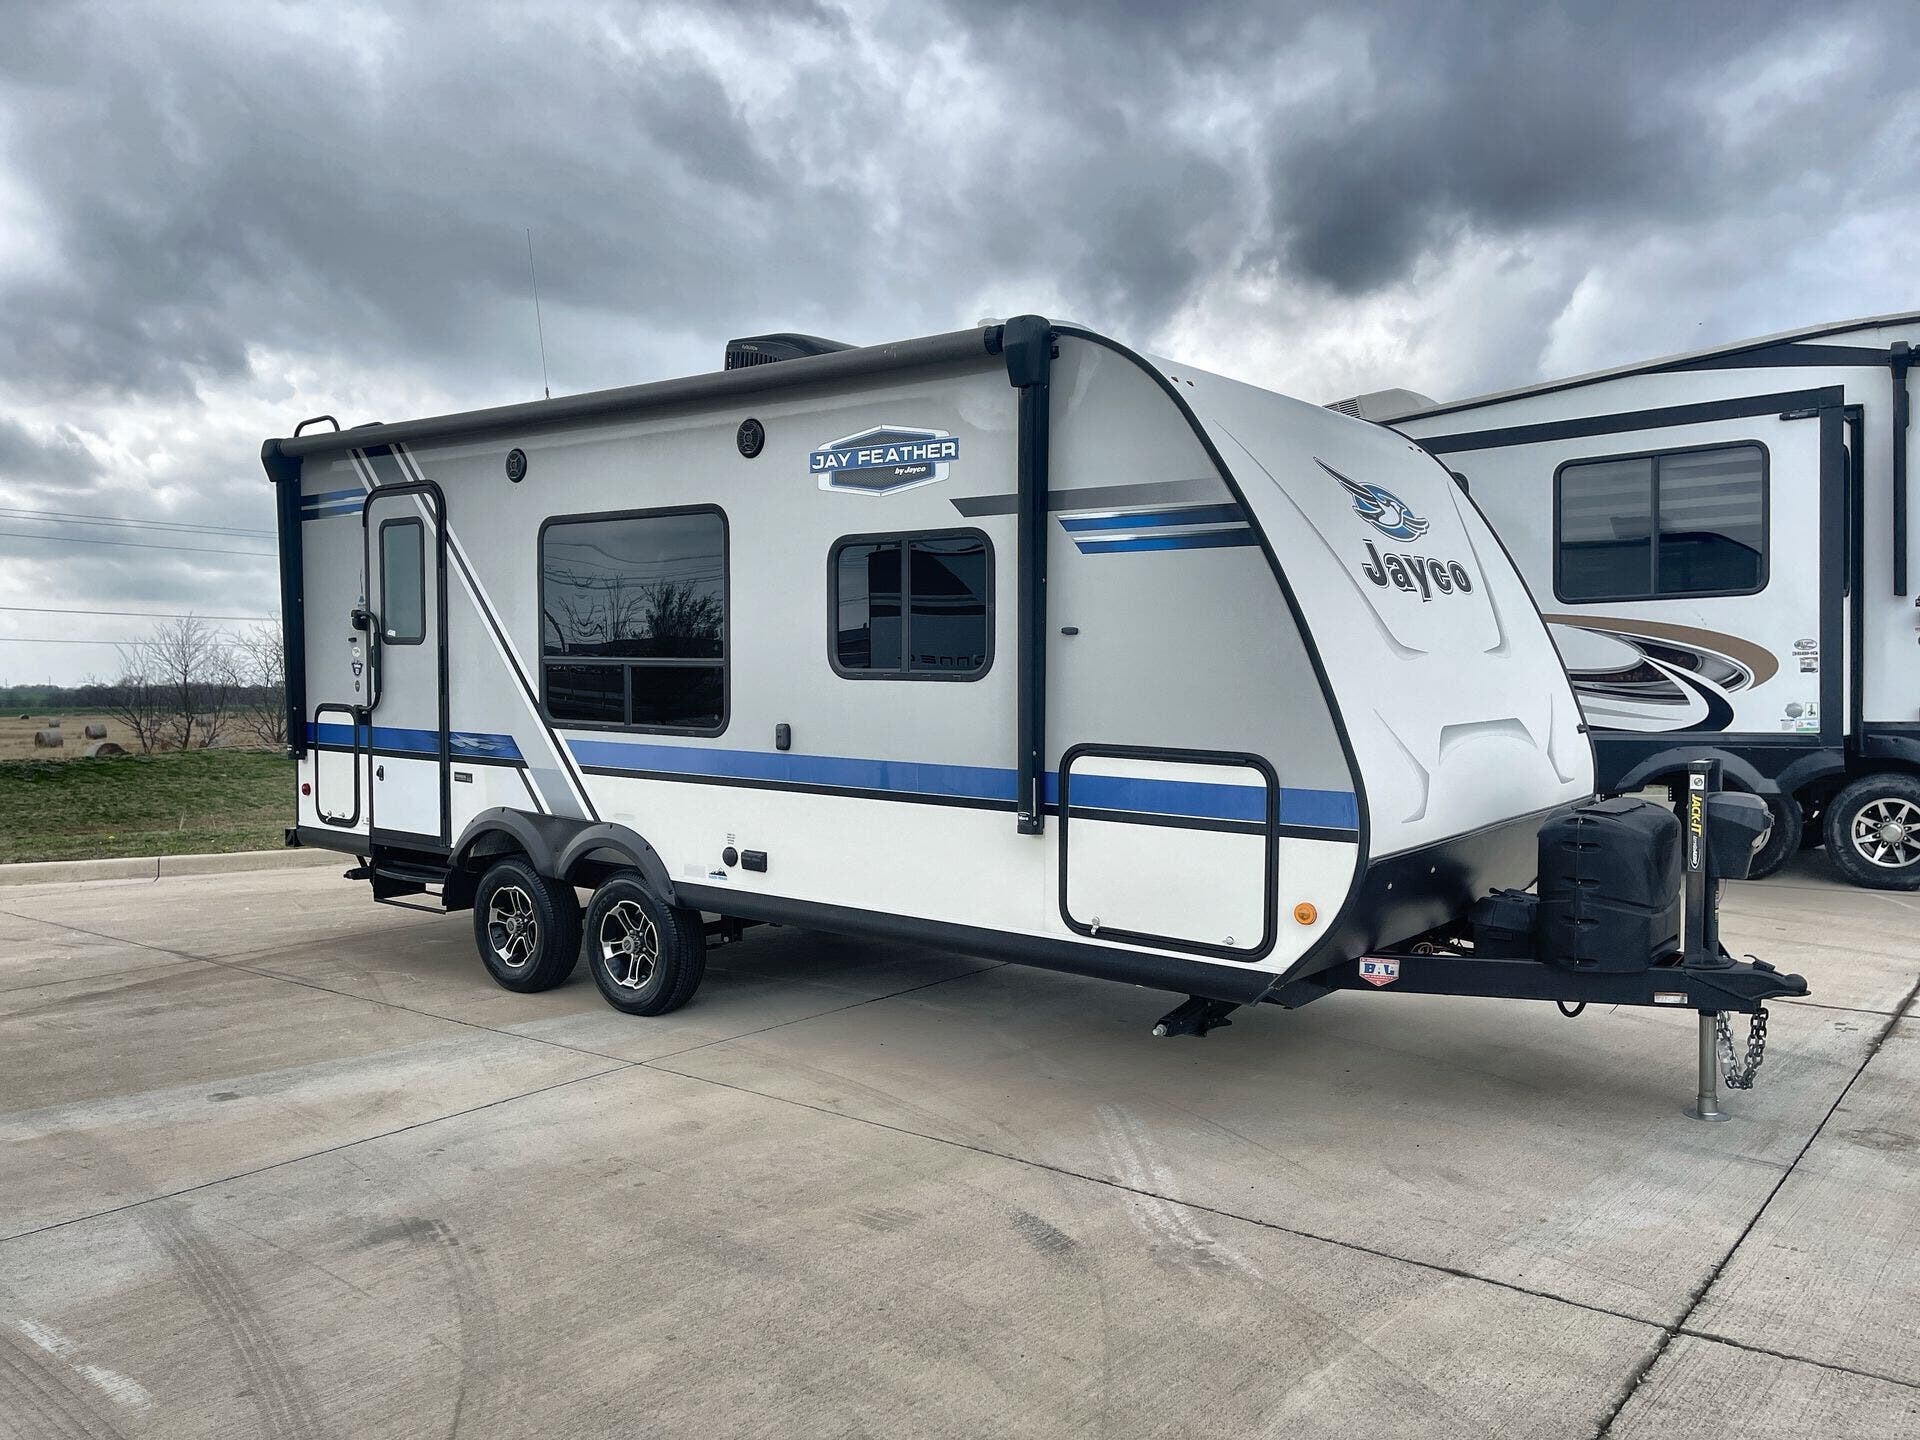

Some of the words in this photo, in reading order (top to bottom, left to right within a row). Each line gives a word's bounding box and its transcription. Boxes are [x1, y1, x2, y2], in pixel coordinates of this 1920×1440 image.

[812, 452, 851, 469] JAY
[857, 442, 956, 465] FEATHER
[895, 467, 904, 475] by
[904, 466, 926, 474] Jayco
[1361, 538, 1473, 602] Jayco
[1691, 793, 1702, 837] JACK-IT
